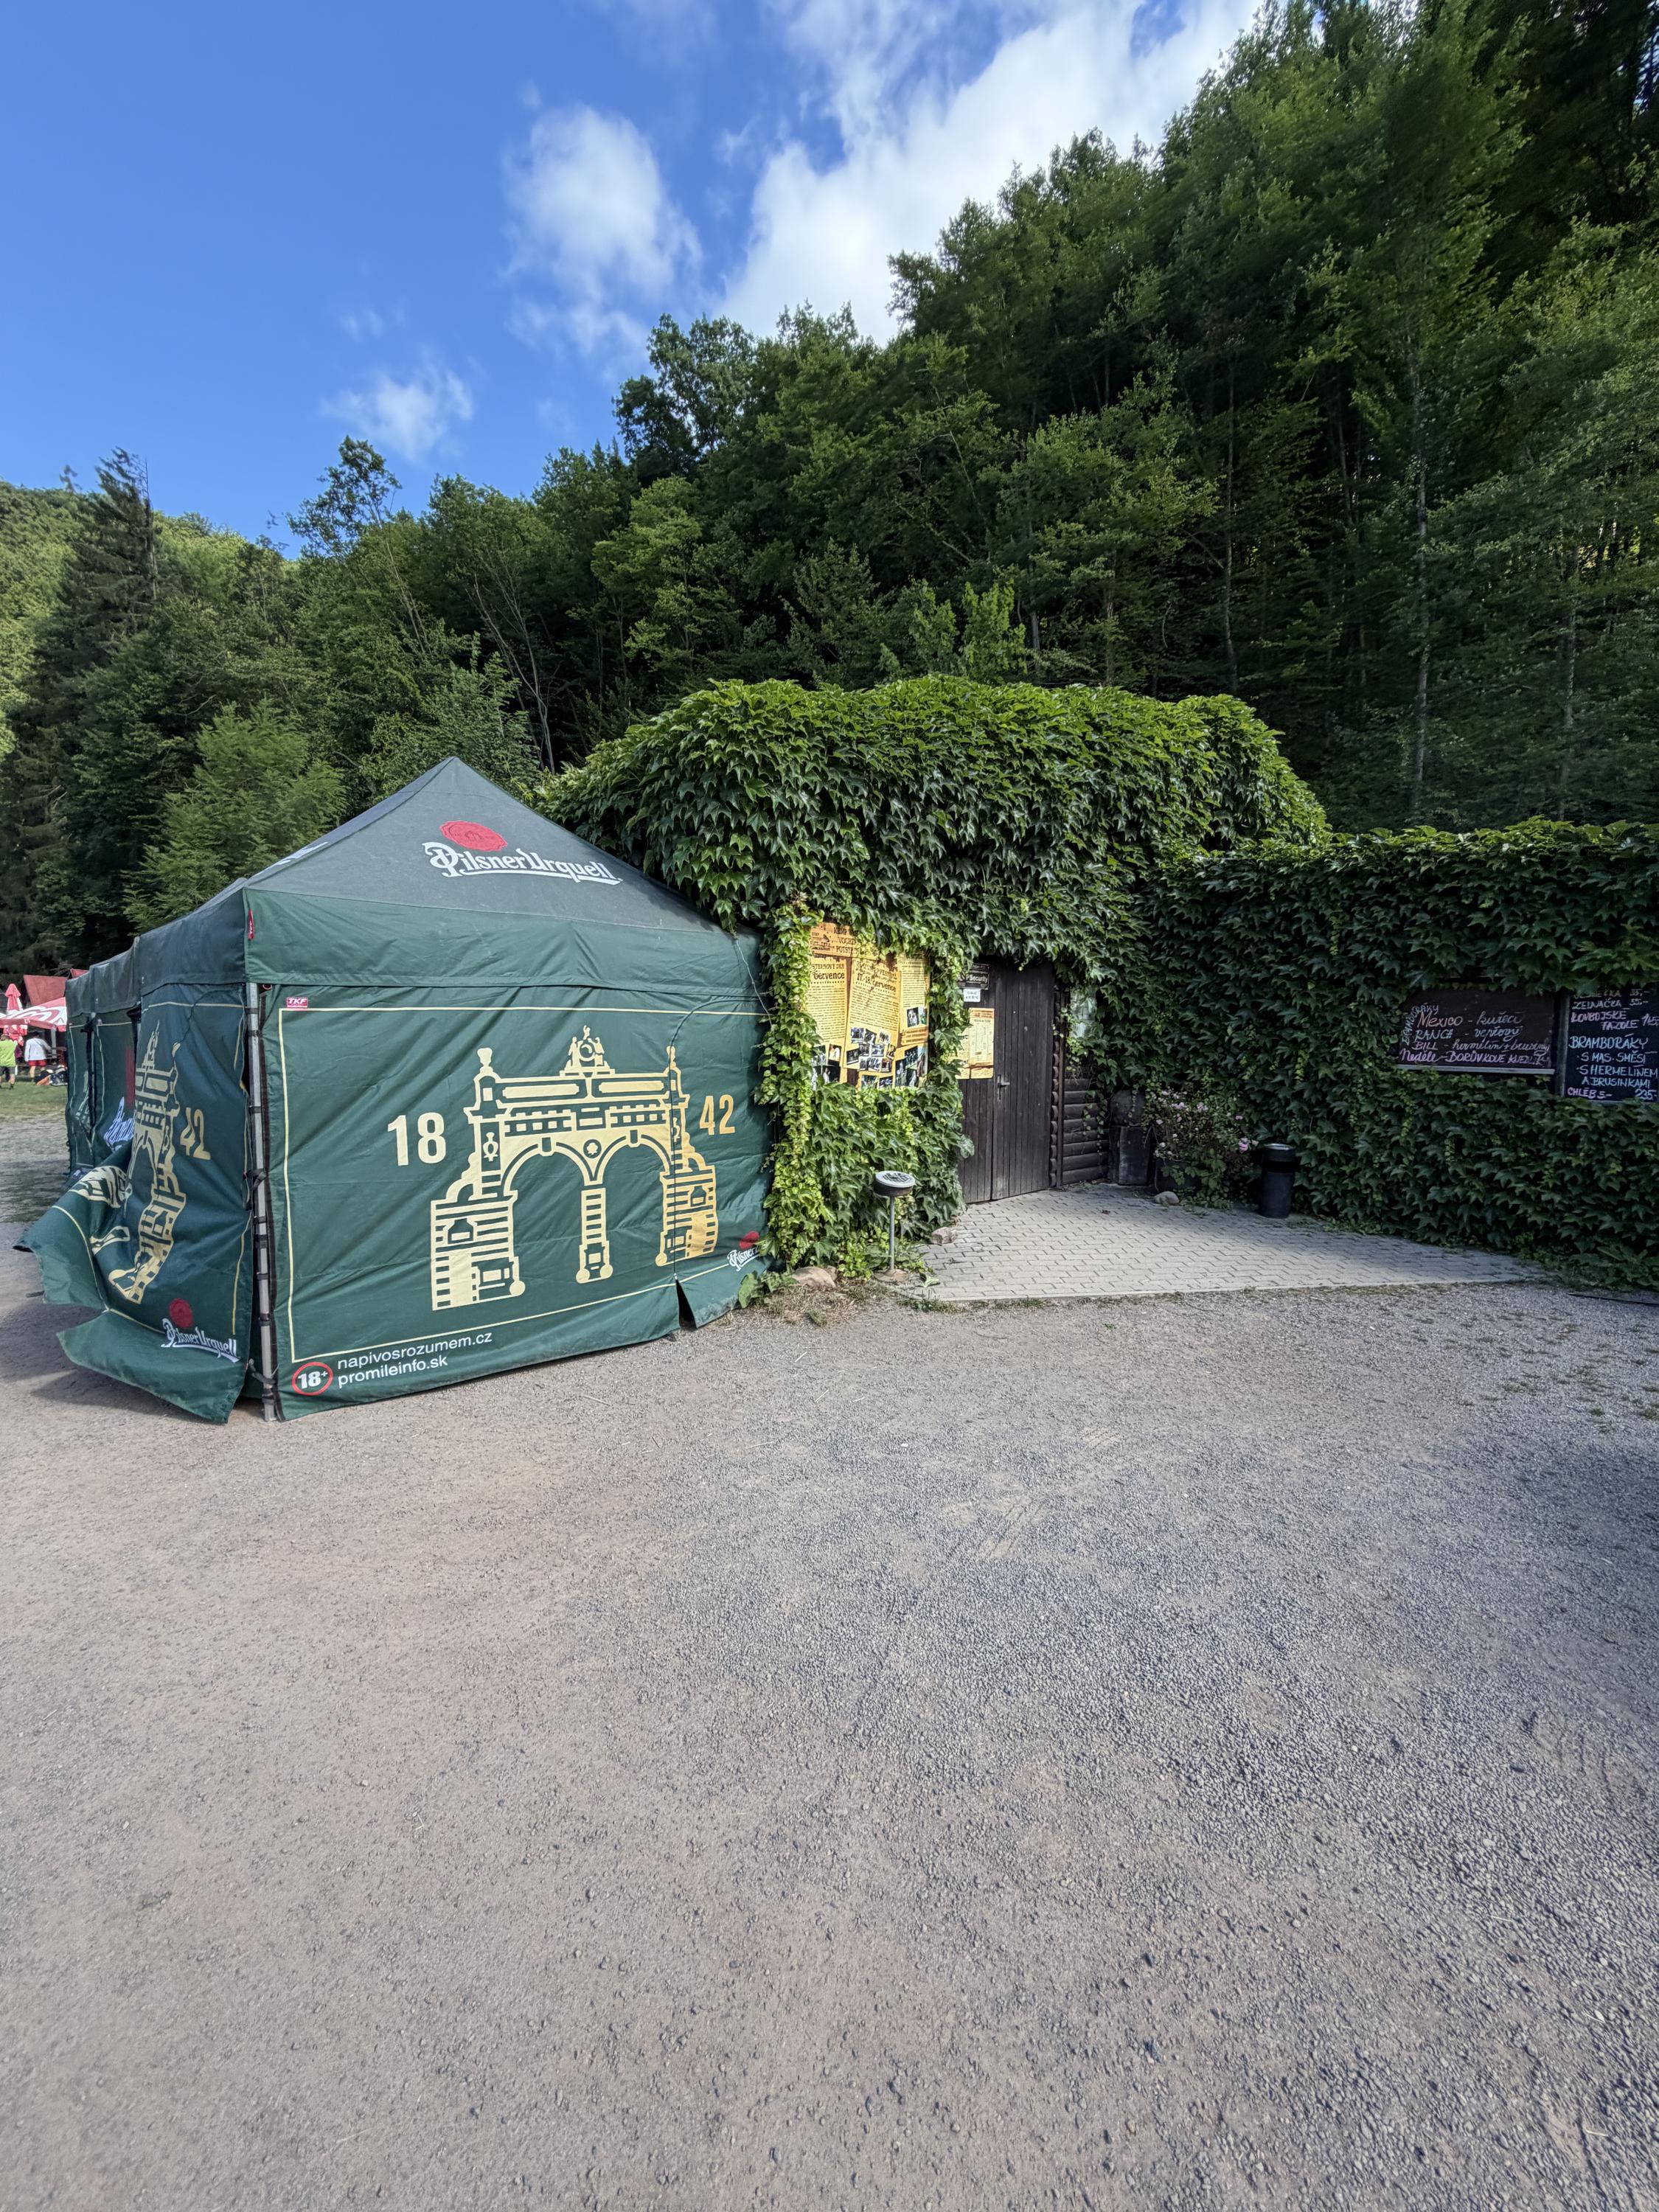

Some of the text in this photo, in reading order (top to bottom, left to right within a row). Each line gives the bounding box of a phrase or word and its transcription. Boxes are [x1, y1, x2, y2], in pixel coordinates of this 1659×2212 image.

[422, 841, 621, 883] Pilsner Urquell
[1568, 1033, 1649, 1049] BRAMBORÁKY
[1581, 1076, 1651, 1089] A BRUSINKAMI
[1590, 1064, 1658, 1078] HERMELÍNEM
[699, 1094, 736, 1135] 42
[180, 1107, 211, 1161] 42
[387, 1112, 447, 1166] 18
[727, 1249, 754, 1272] Pilsner
[161, 1318, 237, 1358] Pilsner Urquell
[337, 1332, 493, 1369] napivosrozumem.cz
[297, 1370, 329, 1389] 18+
[338, 1354, 448, 1389] promileinfo.sk
